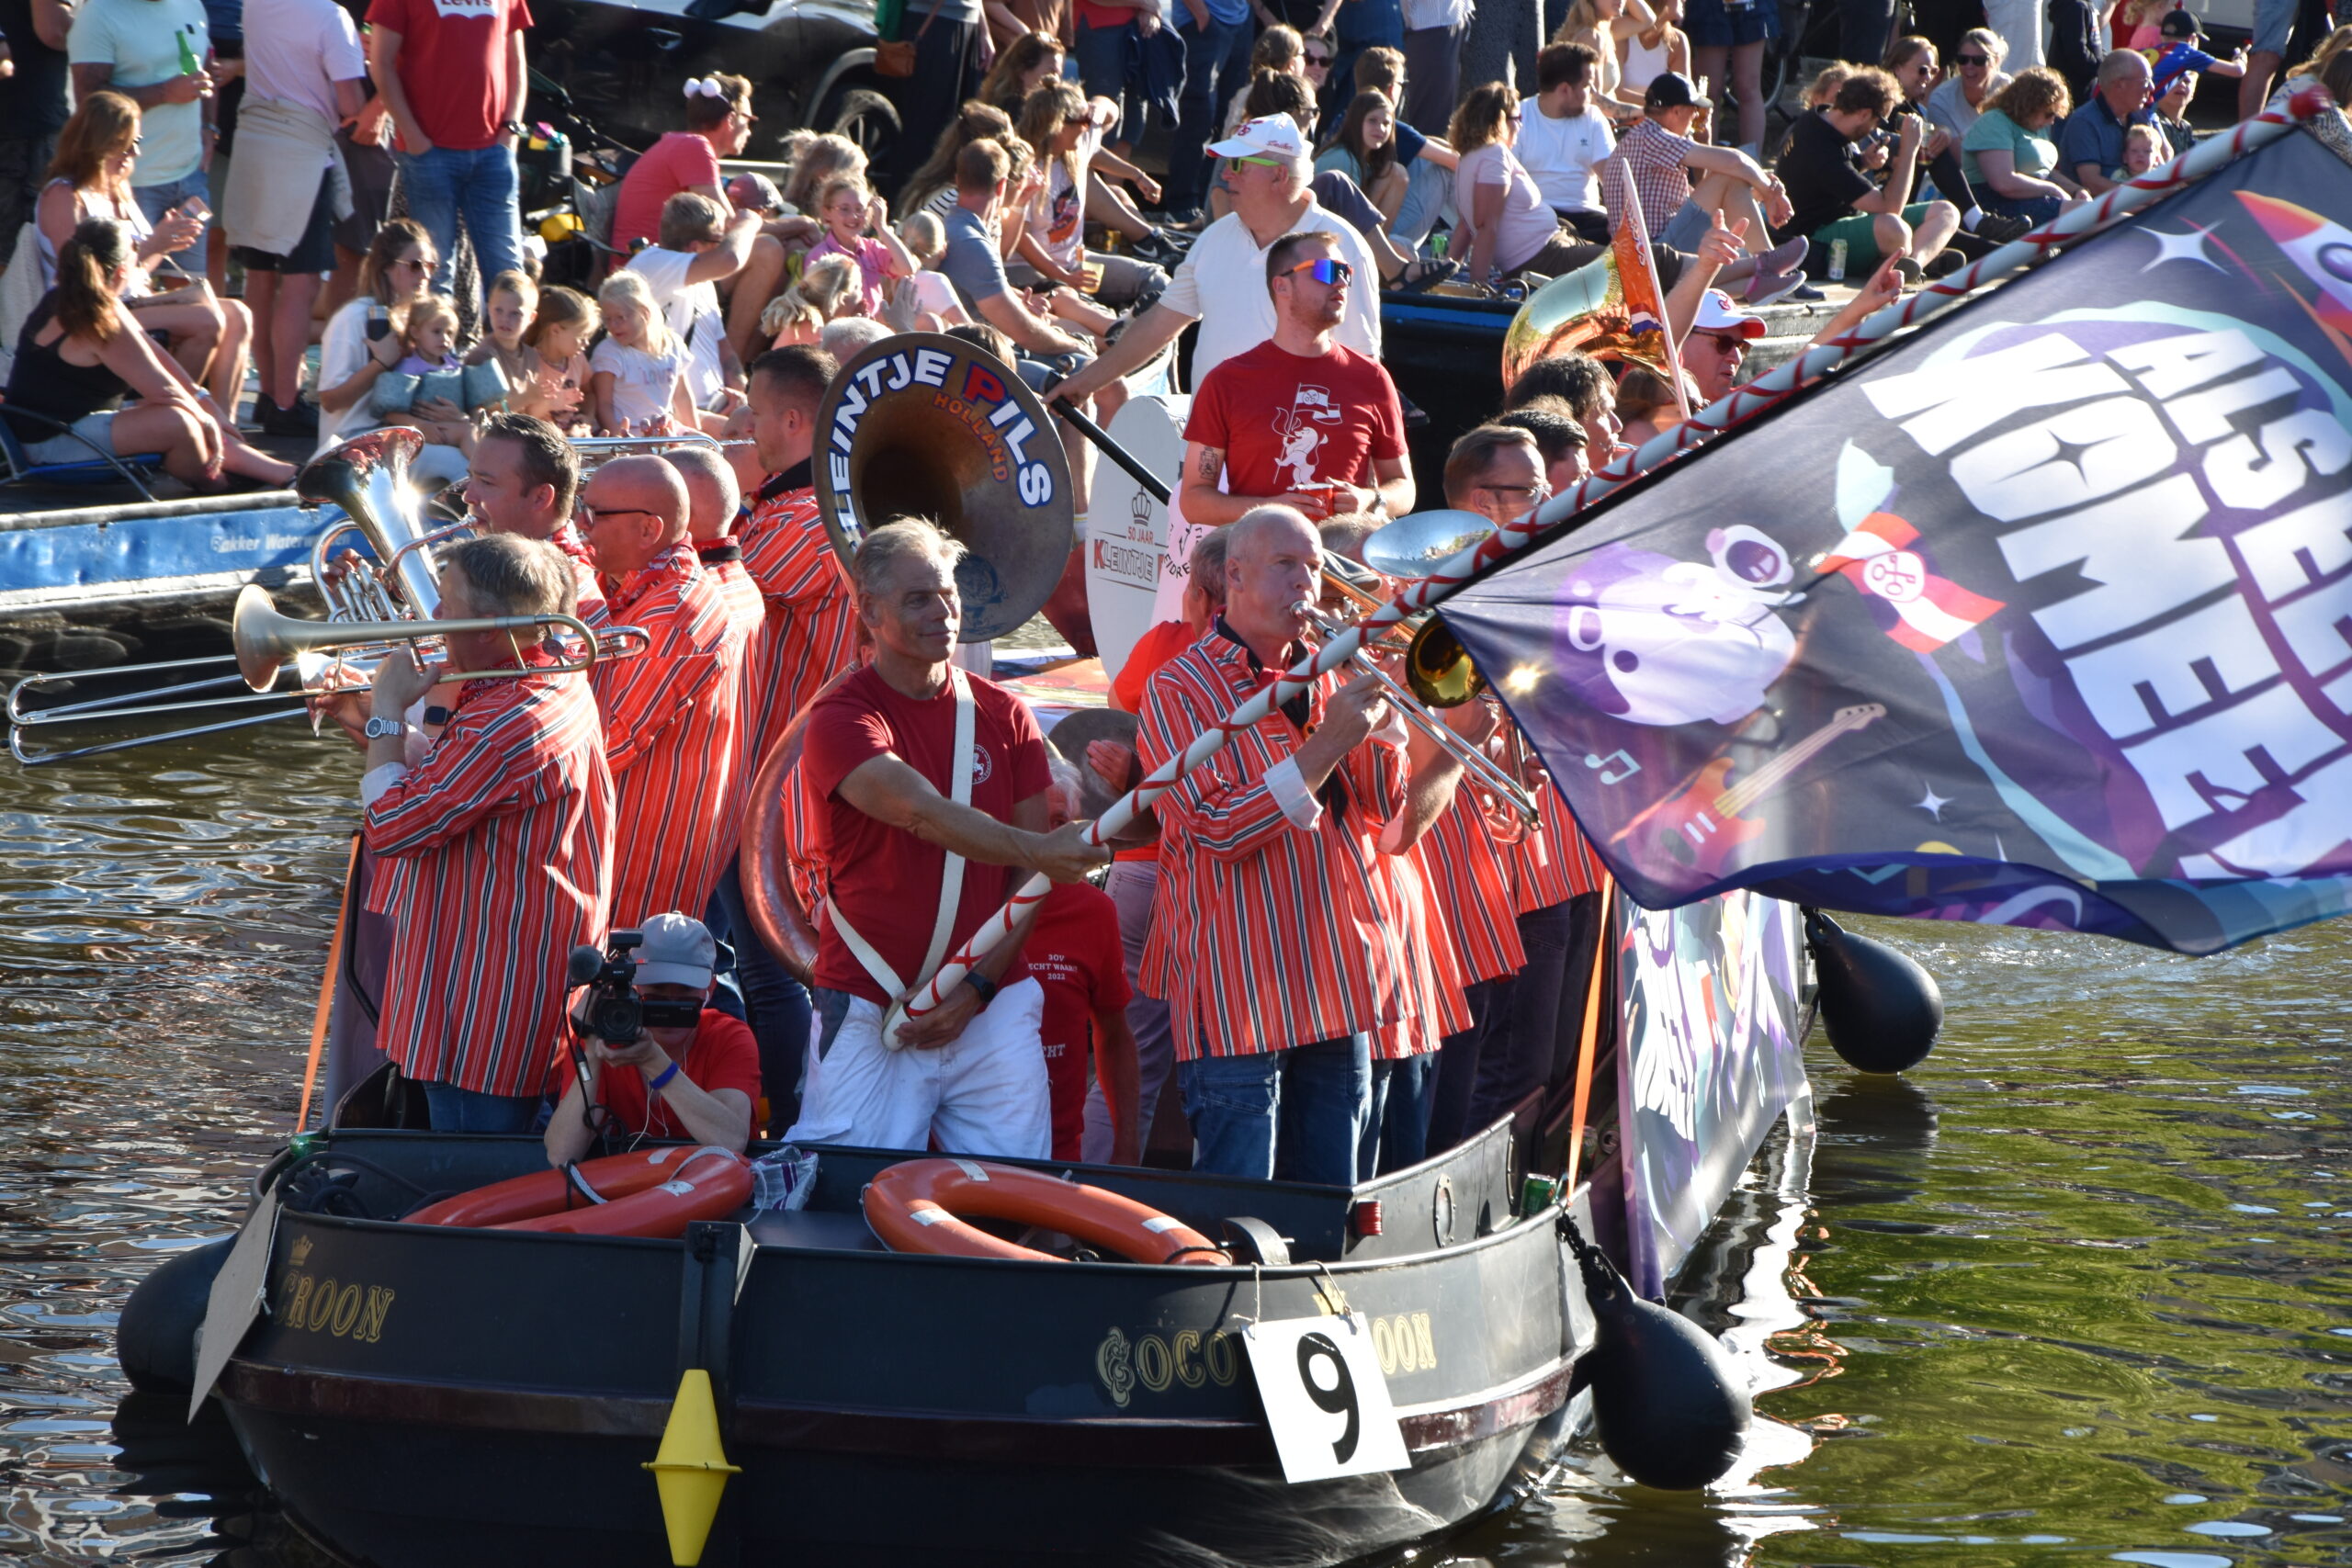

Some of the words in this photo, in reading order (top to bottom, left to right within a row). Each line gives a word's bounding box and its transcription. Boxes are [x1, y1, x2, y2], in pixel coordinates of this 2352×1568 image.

[829, 346, 956, 551] LEINTJE
[963, 361, 1053, 507] PILS
[933, 391, 1010, 483] HOLLAND
[211, 536, 260, 552] Bakker
[1093, 538, 1154, 582] KLEINTJE
[1127, 526, 1136, 540] 50
[1136, 530, 1154, 545] JAAR
[2104, 328, 2352, 511] ALS
[2233, 491, 2352, 718] EE
[277, 1269, 395, 1343] CROON
[1373, 1312, 1437, 1375] OON
[1296, 1331, 1361, 1465] 9
